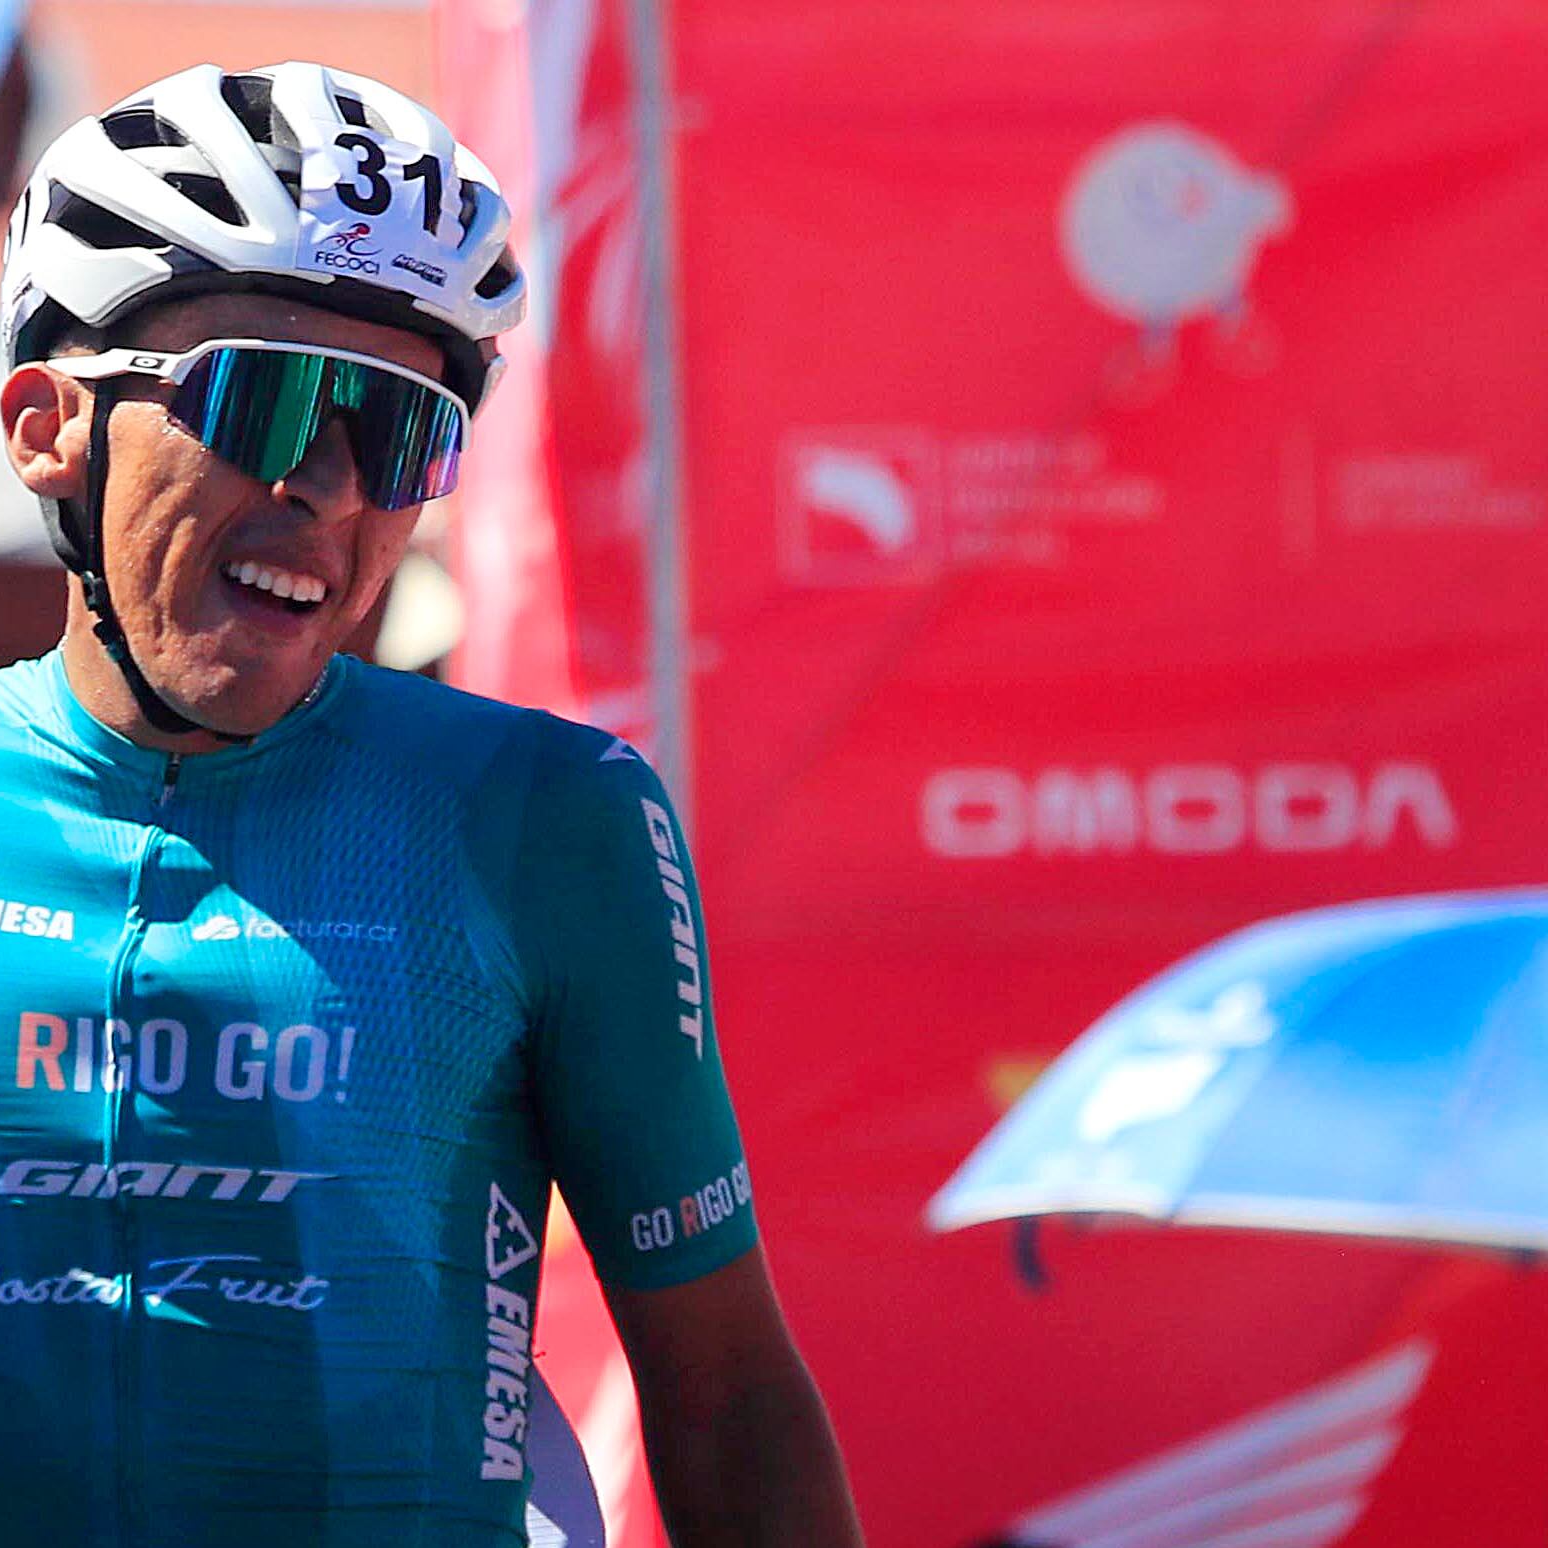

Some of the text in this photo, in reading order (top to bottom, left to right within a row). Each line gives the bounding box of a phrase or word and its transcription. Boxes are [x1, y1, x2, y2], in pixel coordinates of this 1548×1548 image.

[334, 132, 442, 238] 31
[315, 251, 381, 275] FECOCI
[920, 762, 1455, 858] OMODA
[641, 797, 702, 1062] GIANT
[15, 1011, 188, 1096] RIGO
[215, 1021, 357, 1103] GO!
[632, 1207, 675, 1252] GO
[679, 1177, 735, 1239] RIGO
[482, 1282, 530, 1482] EMESA
